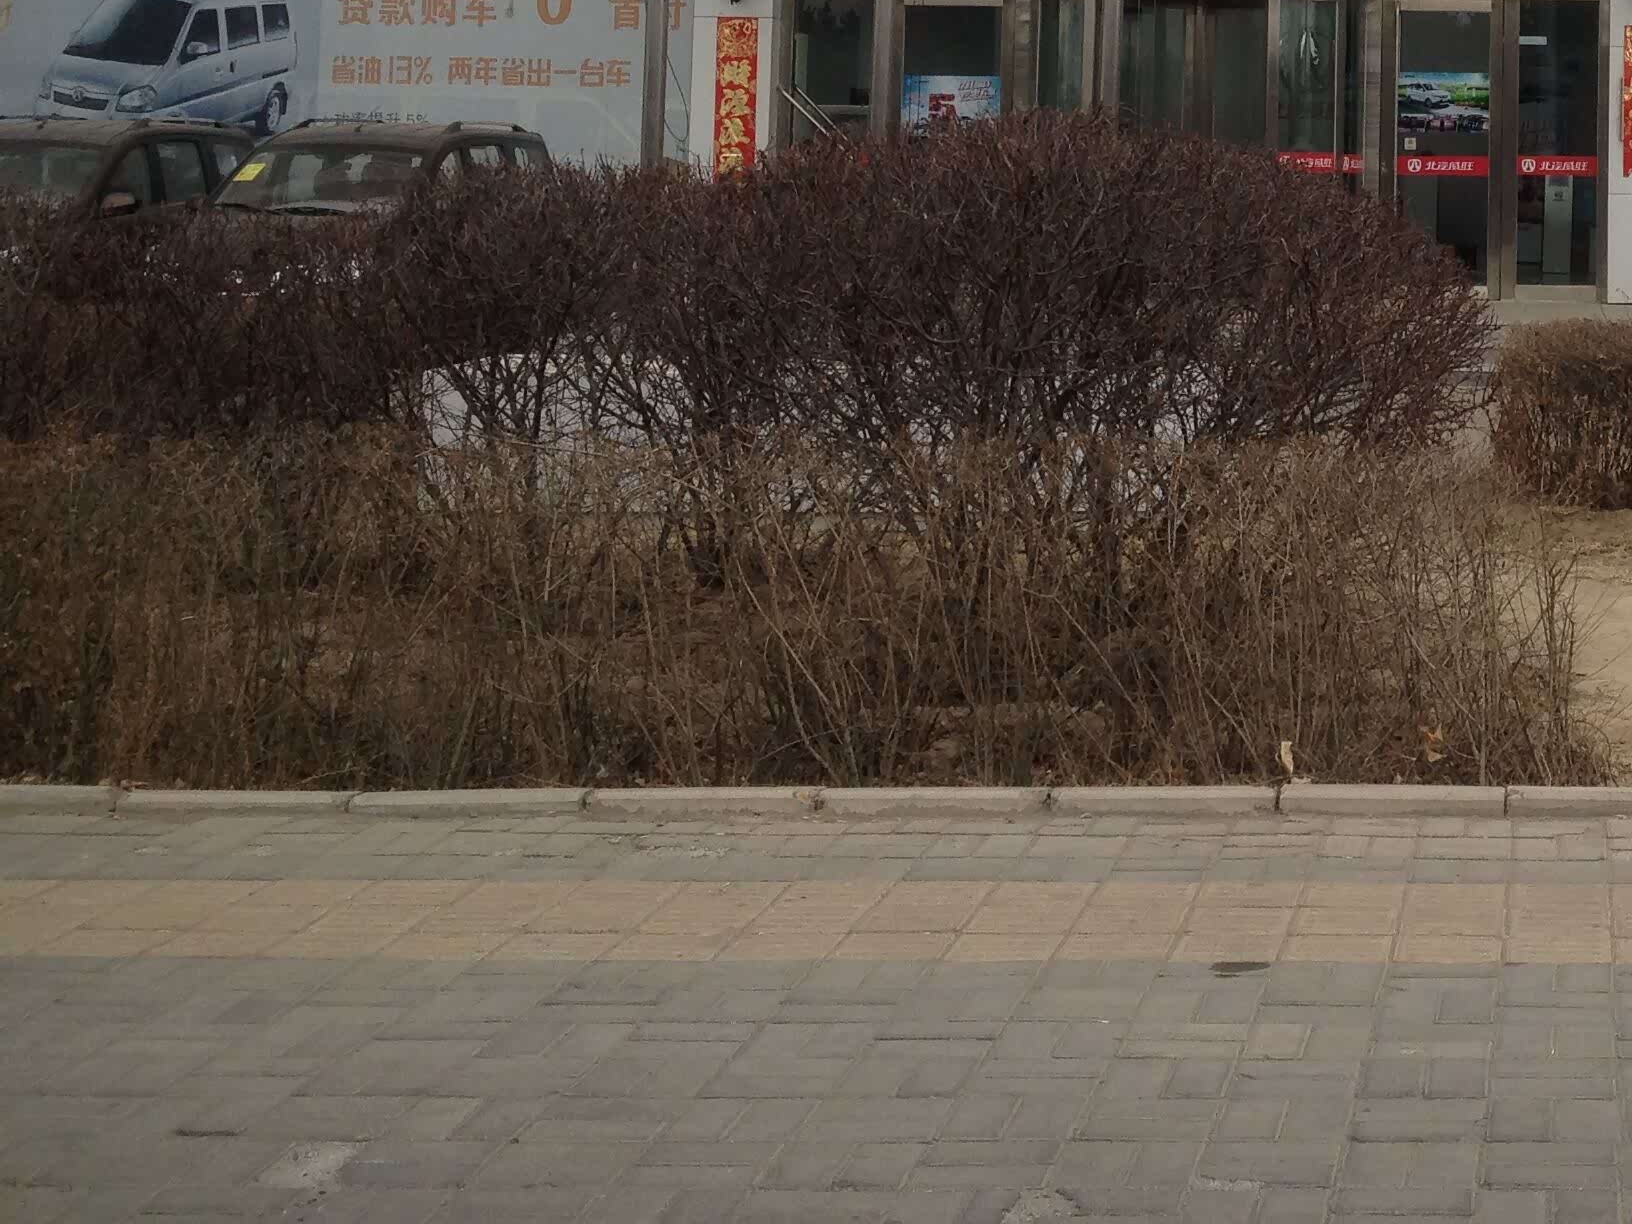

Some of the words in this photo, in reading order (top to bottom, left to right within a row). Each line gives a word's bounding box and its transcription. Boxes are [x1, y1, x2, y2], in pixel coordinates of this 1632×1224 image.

[331, 56, 433, 85] 省油13%
[448, 57, 631, 87] 两年省出一台车
